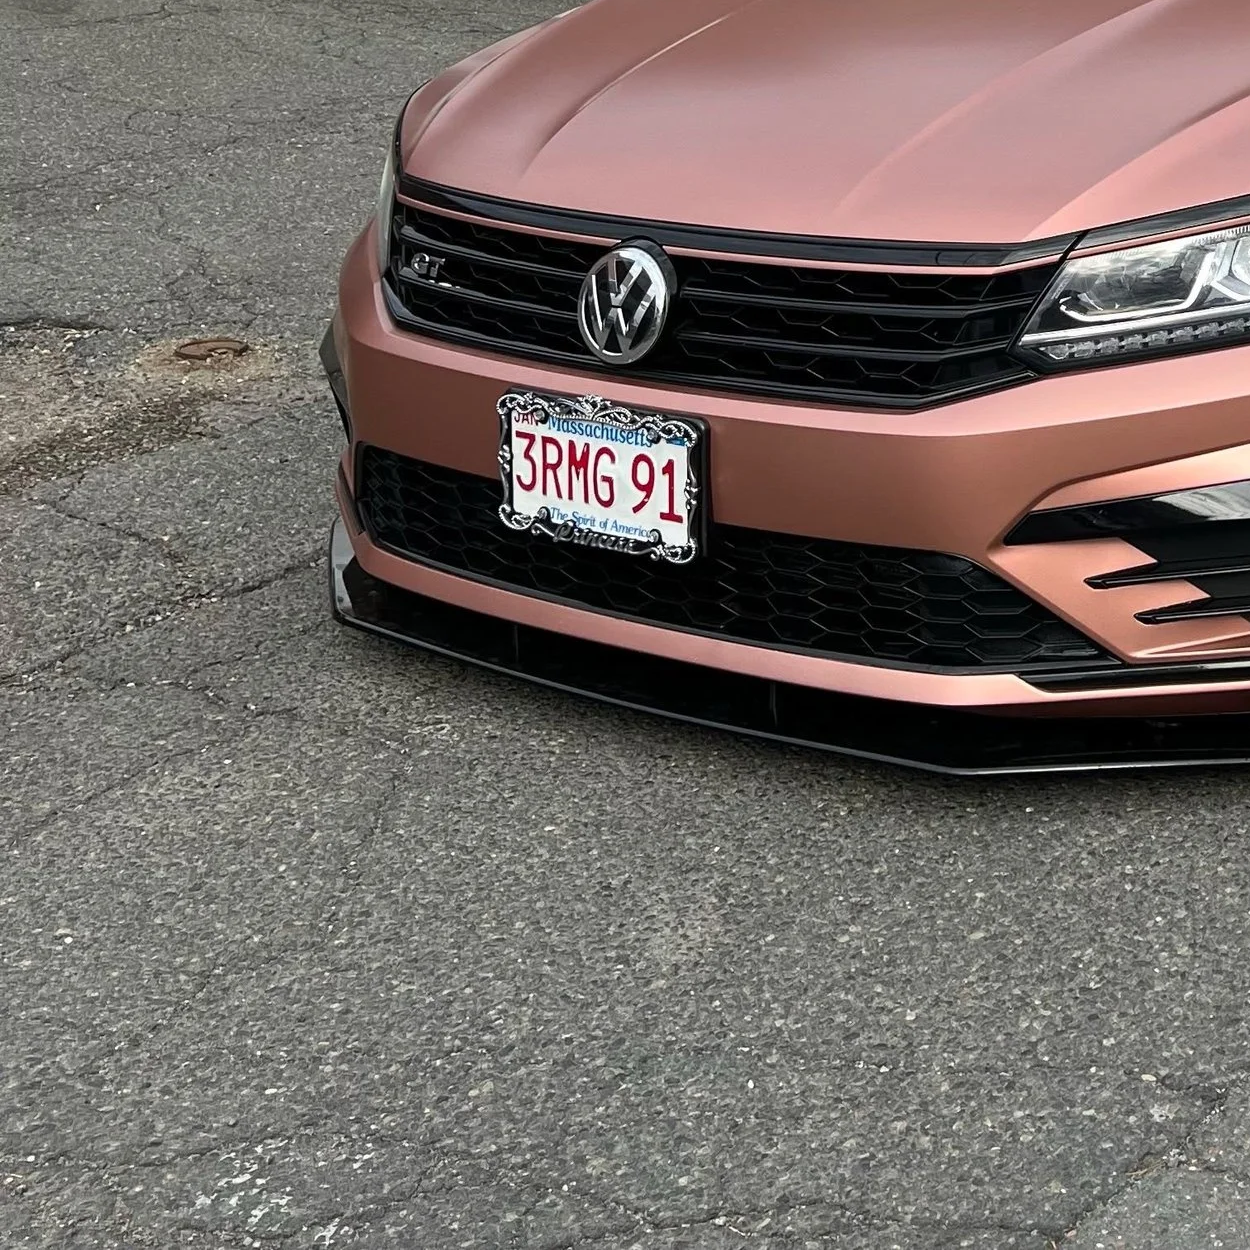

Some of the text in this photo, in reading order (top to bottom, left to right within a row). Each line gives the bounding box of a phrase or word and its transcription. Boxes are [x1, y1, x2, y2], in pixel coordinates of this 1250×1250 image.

[411, 252, 446, 278] GT
[548, 415, 653, 448] Massachusetts
[515, 430, 684, 524] 3RMG 91
[551, 506, 652, 538] The Spirit of America
